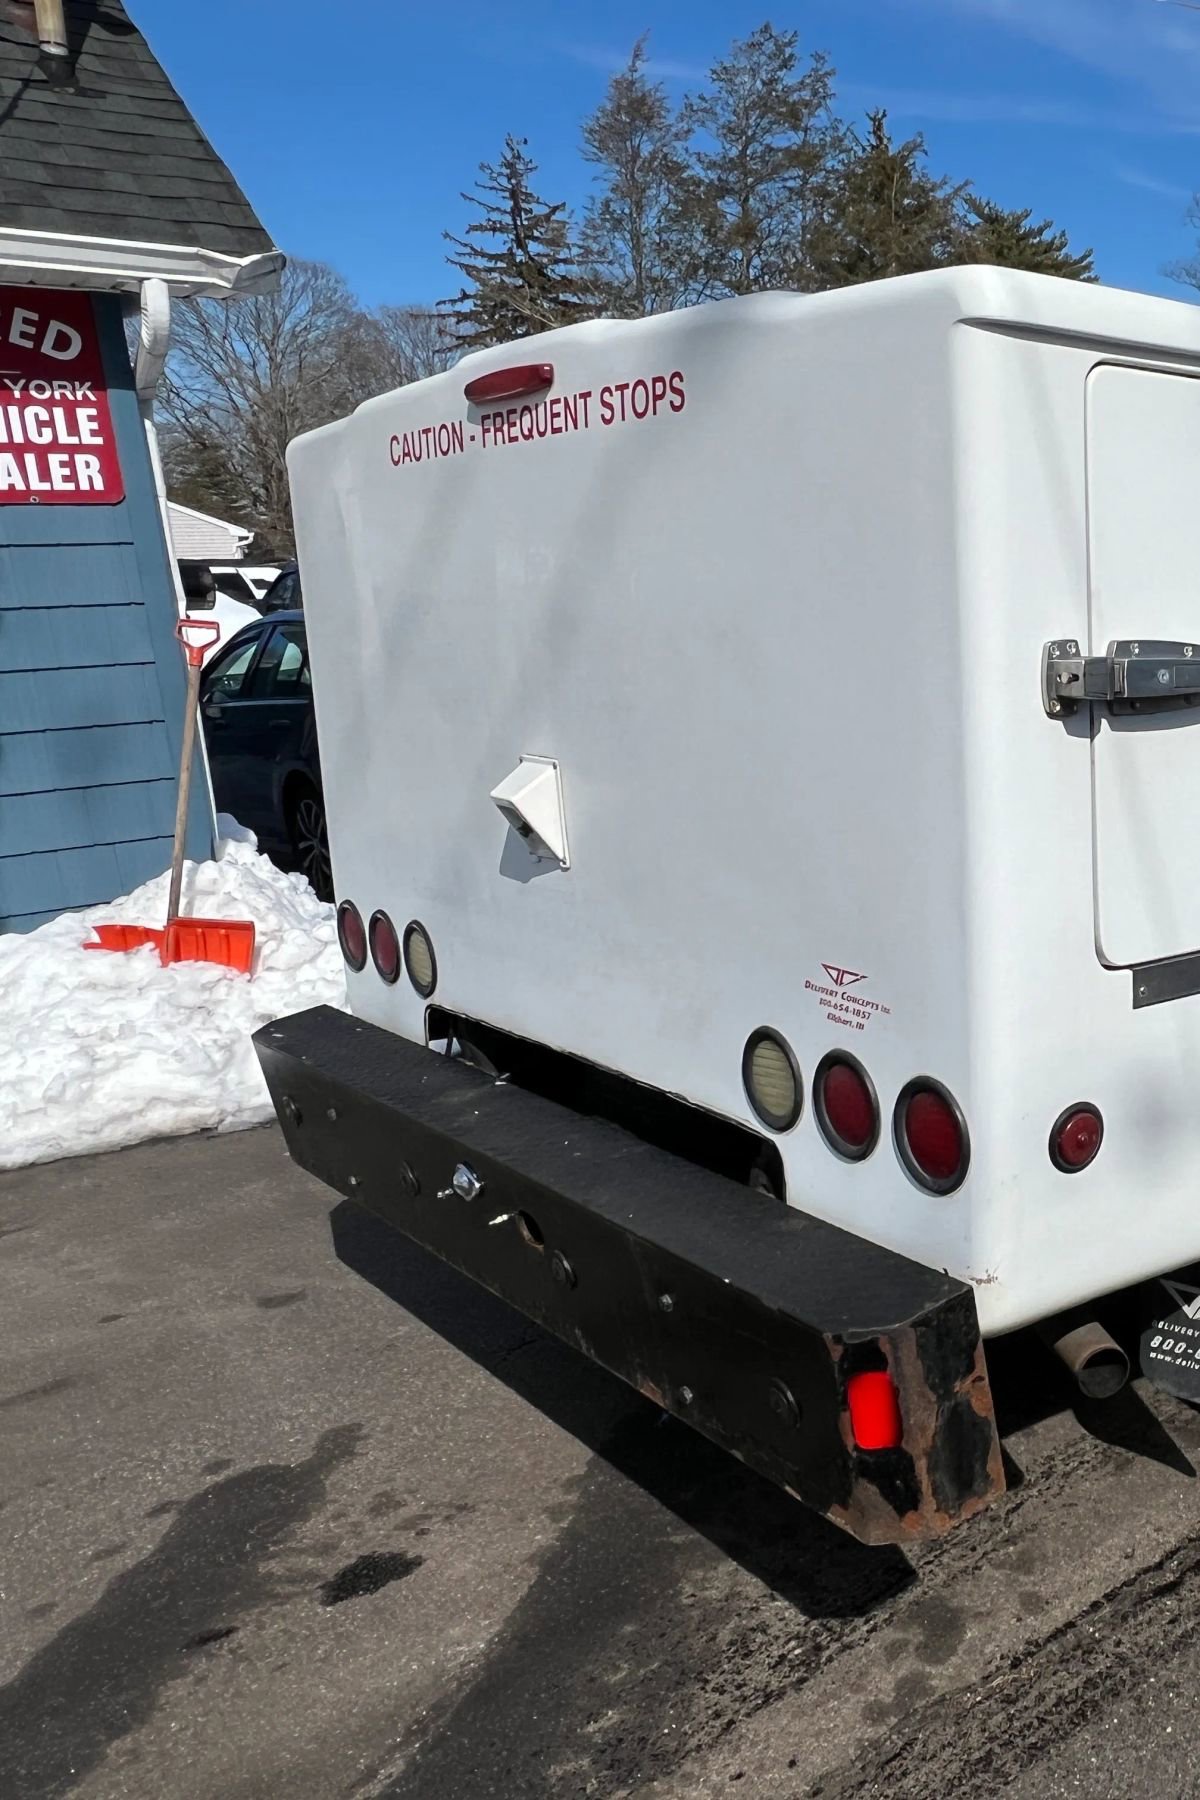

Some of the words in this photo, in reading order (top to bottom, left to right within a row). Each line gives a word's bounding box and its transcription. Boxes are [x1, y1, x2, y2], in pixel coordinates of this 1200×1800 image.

[3, 379, 97, 401] YORK
[390, 420, 464, 466] CAUTION
[481, 390, 592, 448] FREQUENT
[600, 371, 686, 426] STOPS
[804, 979, 839, 998] DELIVERY
[841, 991, 879, 1011] CONCEPTS
